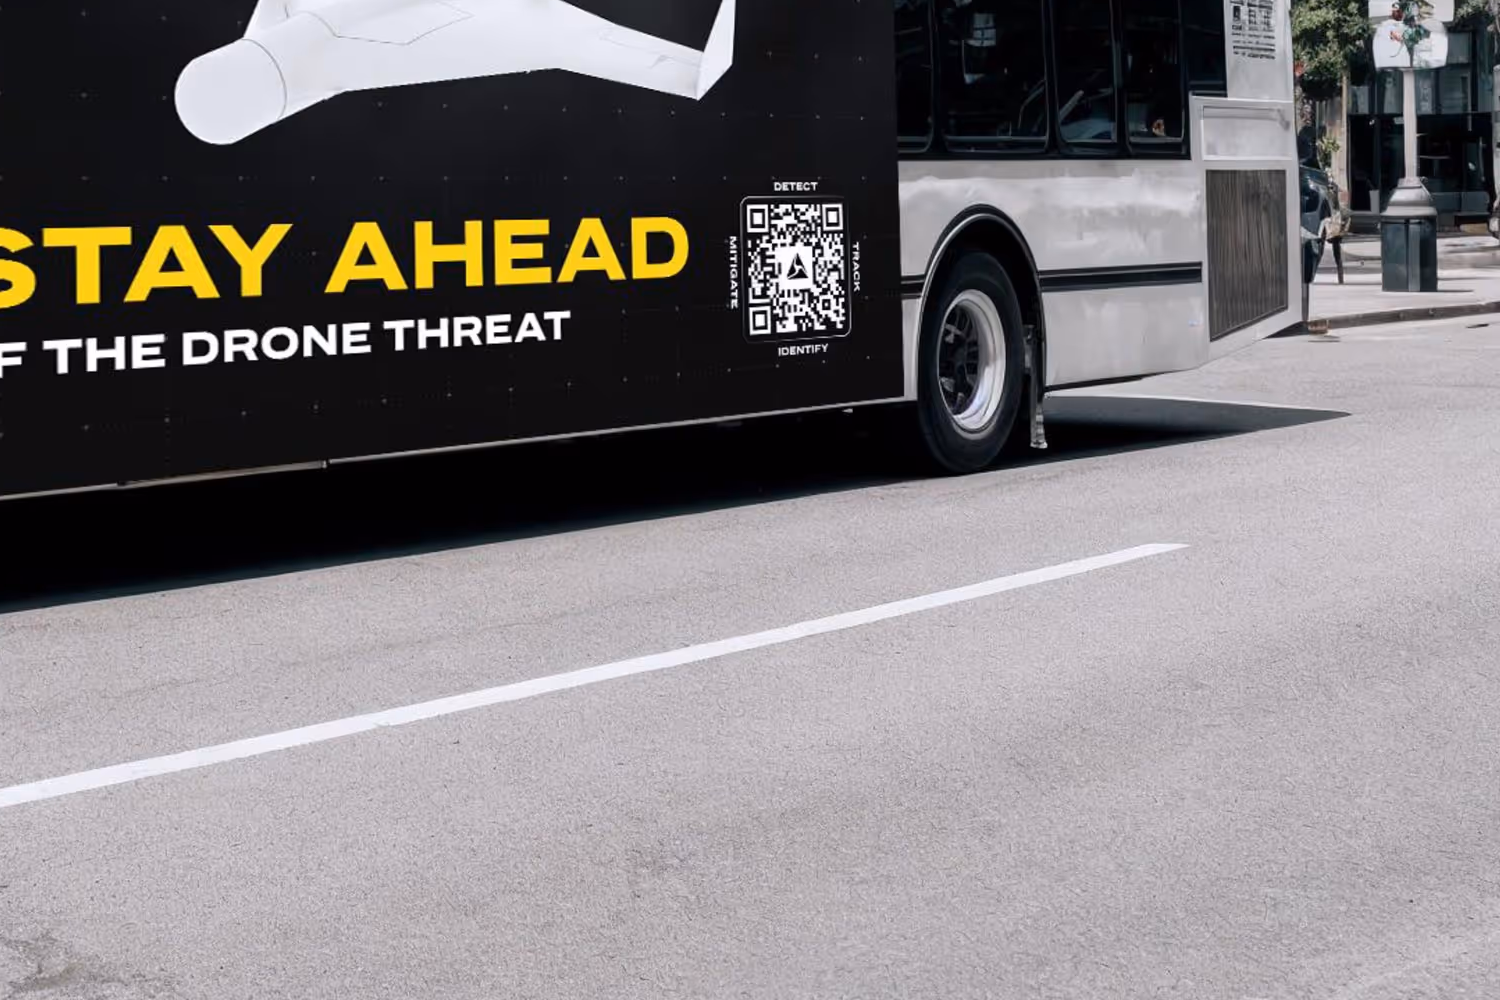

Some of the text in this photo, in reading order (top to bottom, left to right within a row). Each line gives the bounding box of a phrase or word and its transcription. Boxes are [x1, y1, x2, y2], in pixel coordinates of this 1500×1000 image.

[774, 182, 818, 191] DETECT
[325, 217, 690, 293] AHEAD
[729, 235, 739, 309] MITIGATE
[852, 241, 861, 292] TRACK
[43, 334, 165, 374] THE
[182, 322, 371, 365] DRONE
[383, 311, 571, 351] THREAT
[778, 343, 829, 356] IDENTIFY
